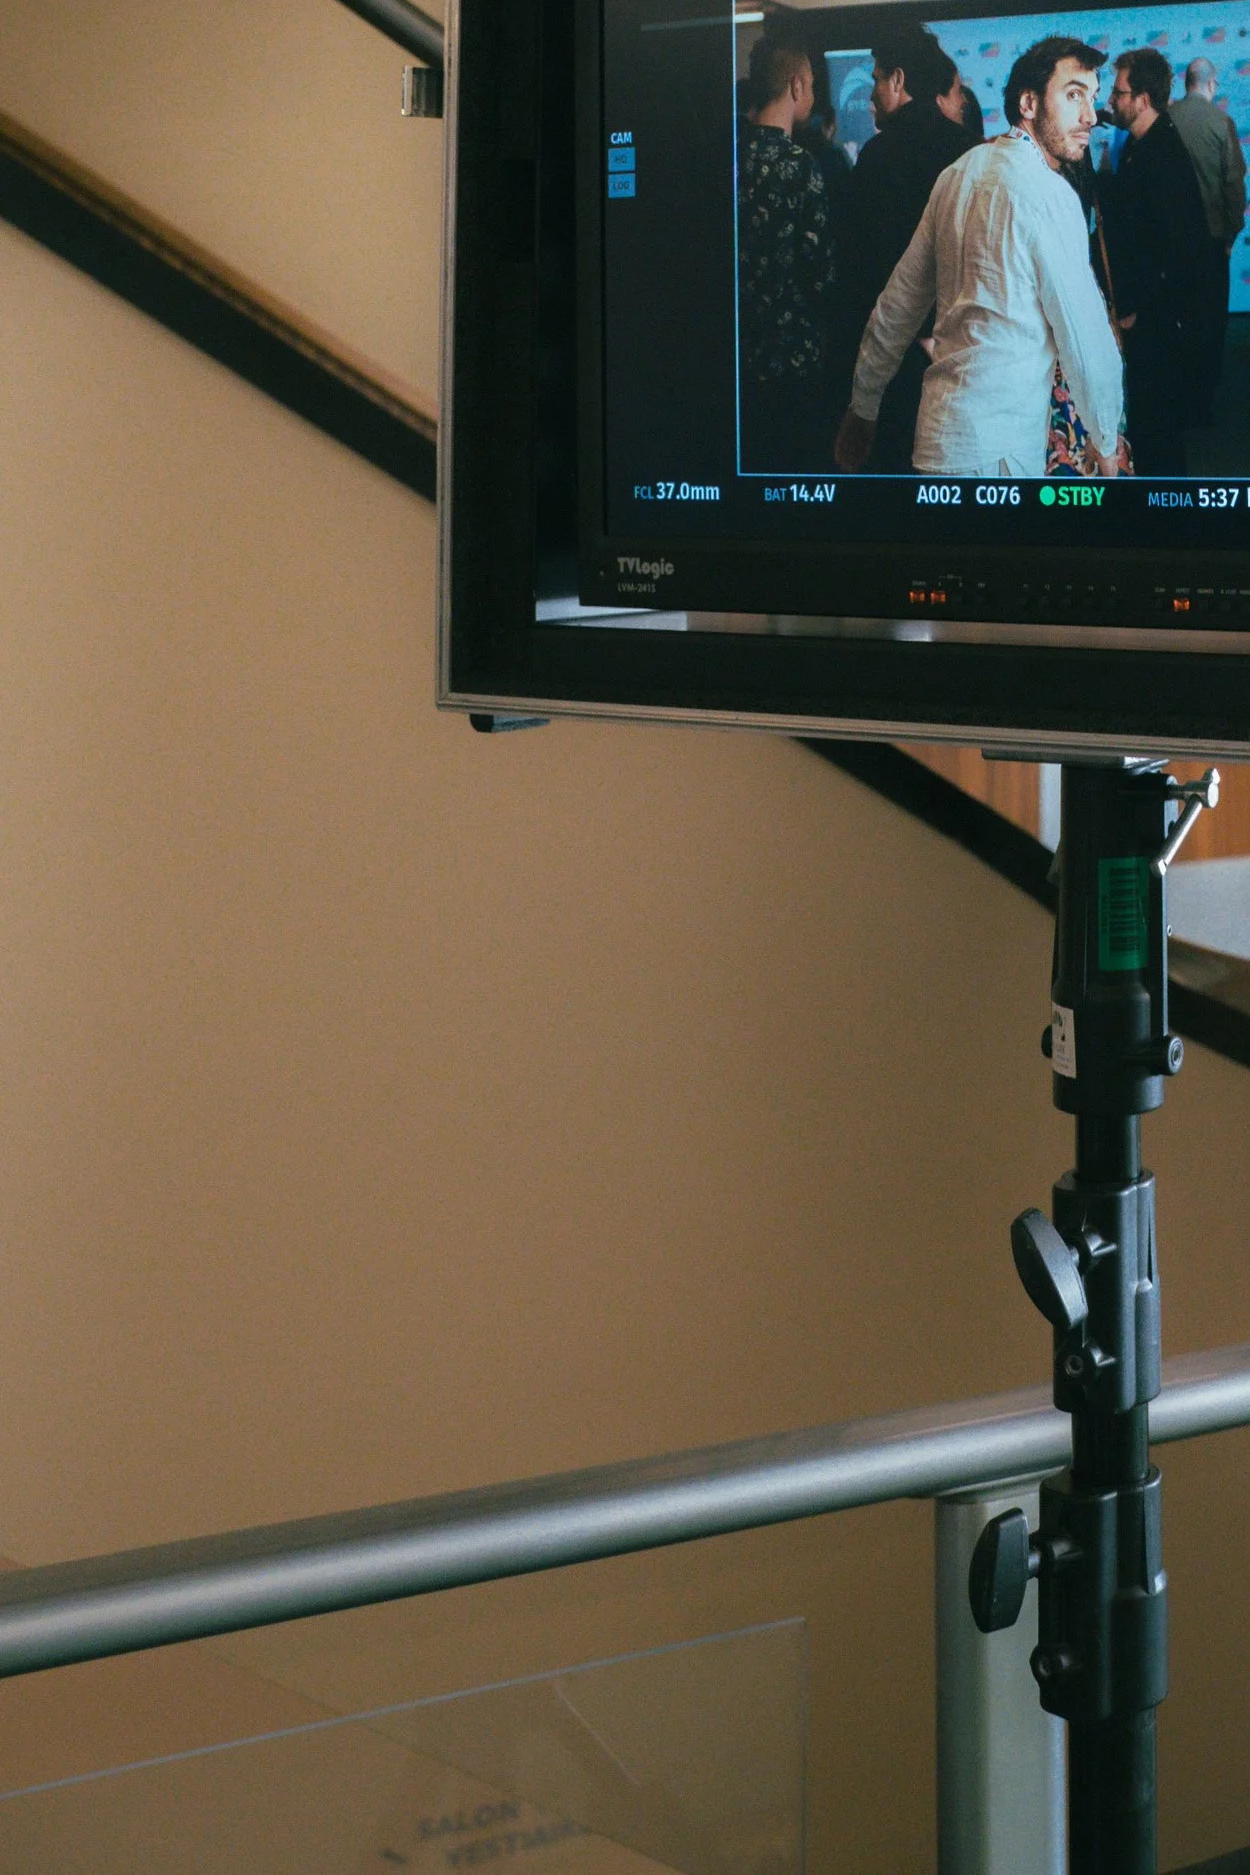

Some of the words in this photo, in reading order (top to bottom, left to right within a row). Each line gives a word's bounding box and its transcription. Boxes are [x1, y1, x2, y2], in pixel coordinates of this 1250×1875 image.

[611, 131, 632, 144] CAM
[634, 485, 654, 500] FCL
[656, 481, 721, 501] 37.0mm
[764, 487, 787, 502] BAT
[790, 483, 836, 503] 14.4V
[916, 484, 962, 505] A002
[975, 485, 1021, 506] C076
[1058, 486, 1106, 507] STBY
[1148, 492, 1194, 508] MEDIA
[1198, 488, 1240, 509] 5:37
